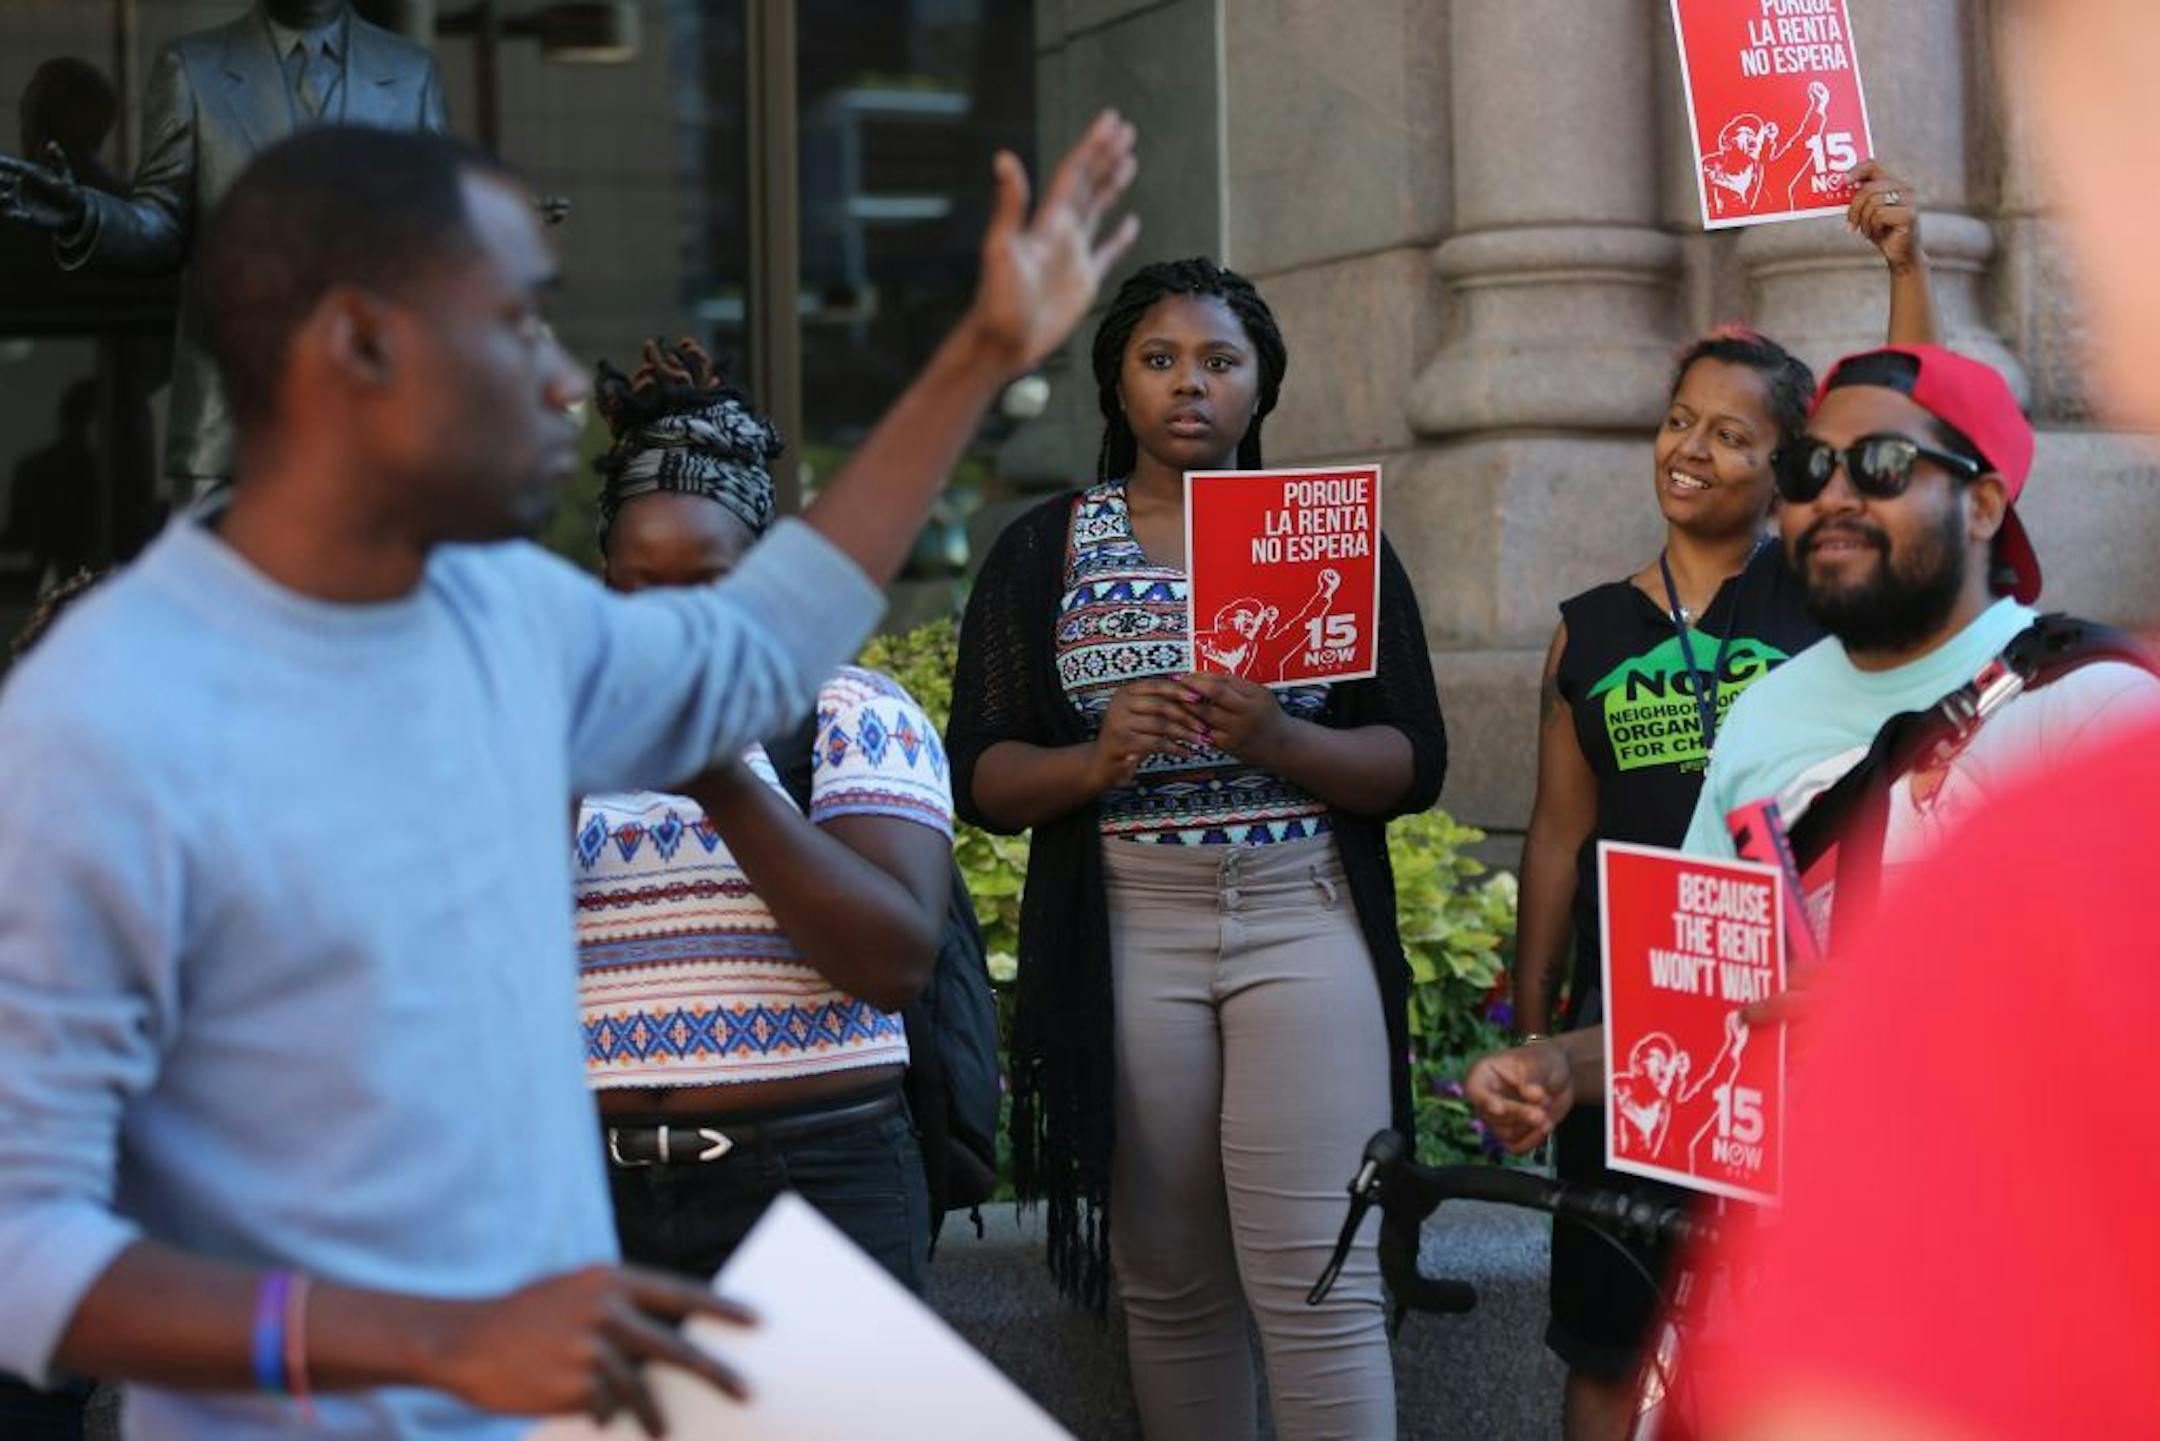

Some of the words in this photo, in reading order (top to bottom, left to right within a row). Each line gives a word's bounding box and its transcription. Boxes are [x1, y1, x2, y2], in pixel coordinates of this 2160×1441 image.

[1748, 17, 1776, 47] LA
[1777, 14, 1843, 44] RENTA
[1740, 47, 1771, 77] NO
[1773, 42, 1849, 73] ESPERA
[1805, 132, 1857, 174] 15
[1811, 172, 1848, 194] NO
[1284, 478, 1369, 507] PORQUE
[1265, 509, 1294, 536] LA
[1298, 505, 1368, 534] RENTA
[1251, 537, 1281, 564] NO
[1286, 531, 1370, 562] ESPERA
[1305, 613, 1357, 650] 15
[1304, 646, 1356, 667] NOW
[1620, 742, 1665, 760] FOR
[1678, 872, 1771, 924] BECAUSE
[1672, 911, 1714, 956] THE
[1717, 918, 1772, 966] RENT
[1649, 947, 1716, 996] WON'T
[1719, 961, 1773, 1003] WAIT
[1713, 1083, 1765, 1142] 15
[1712, 1137, 1763, 1171] NOW
